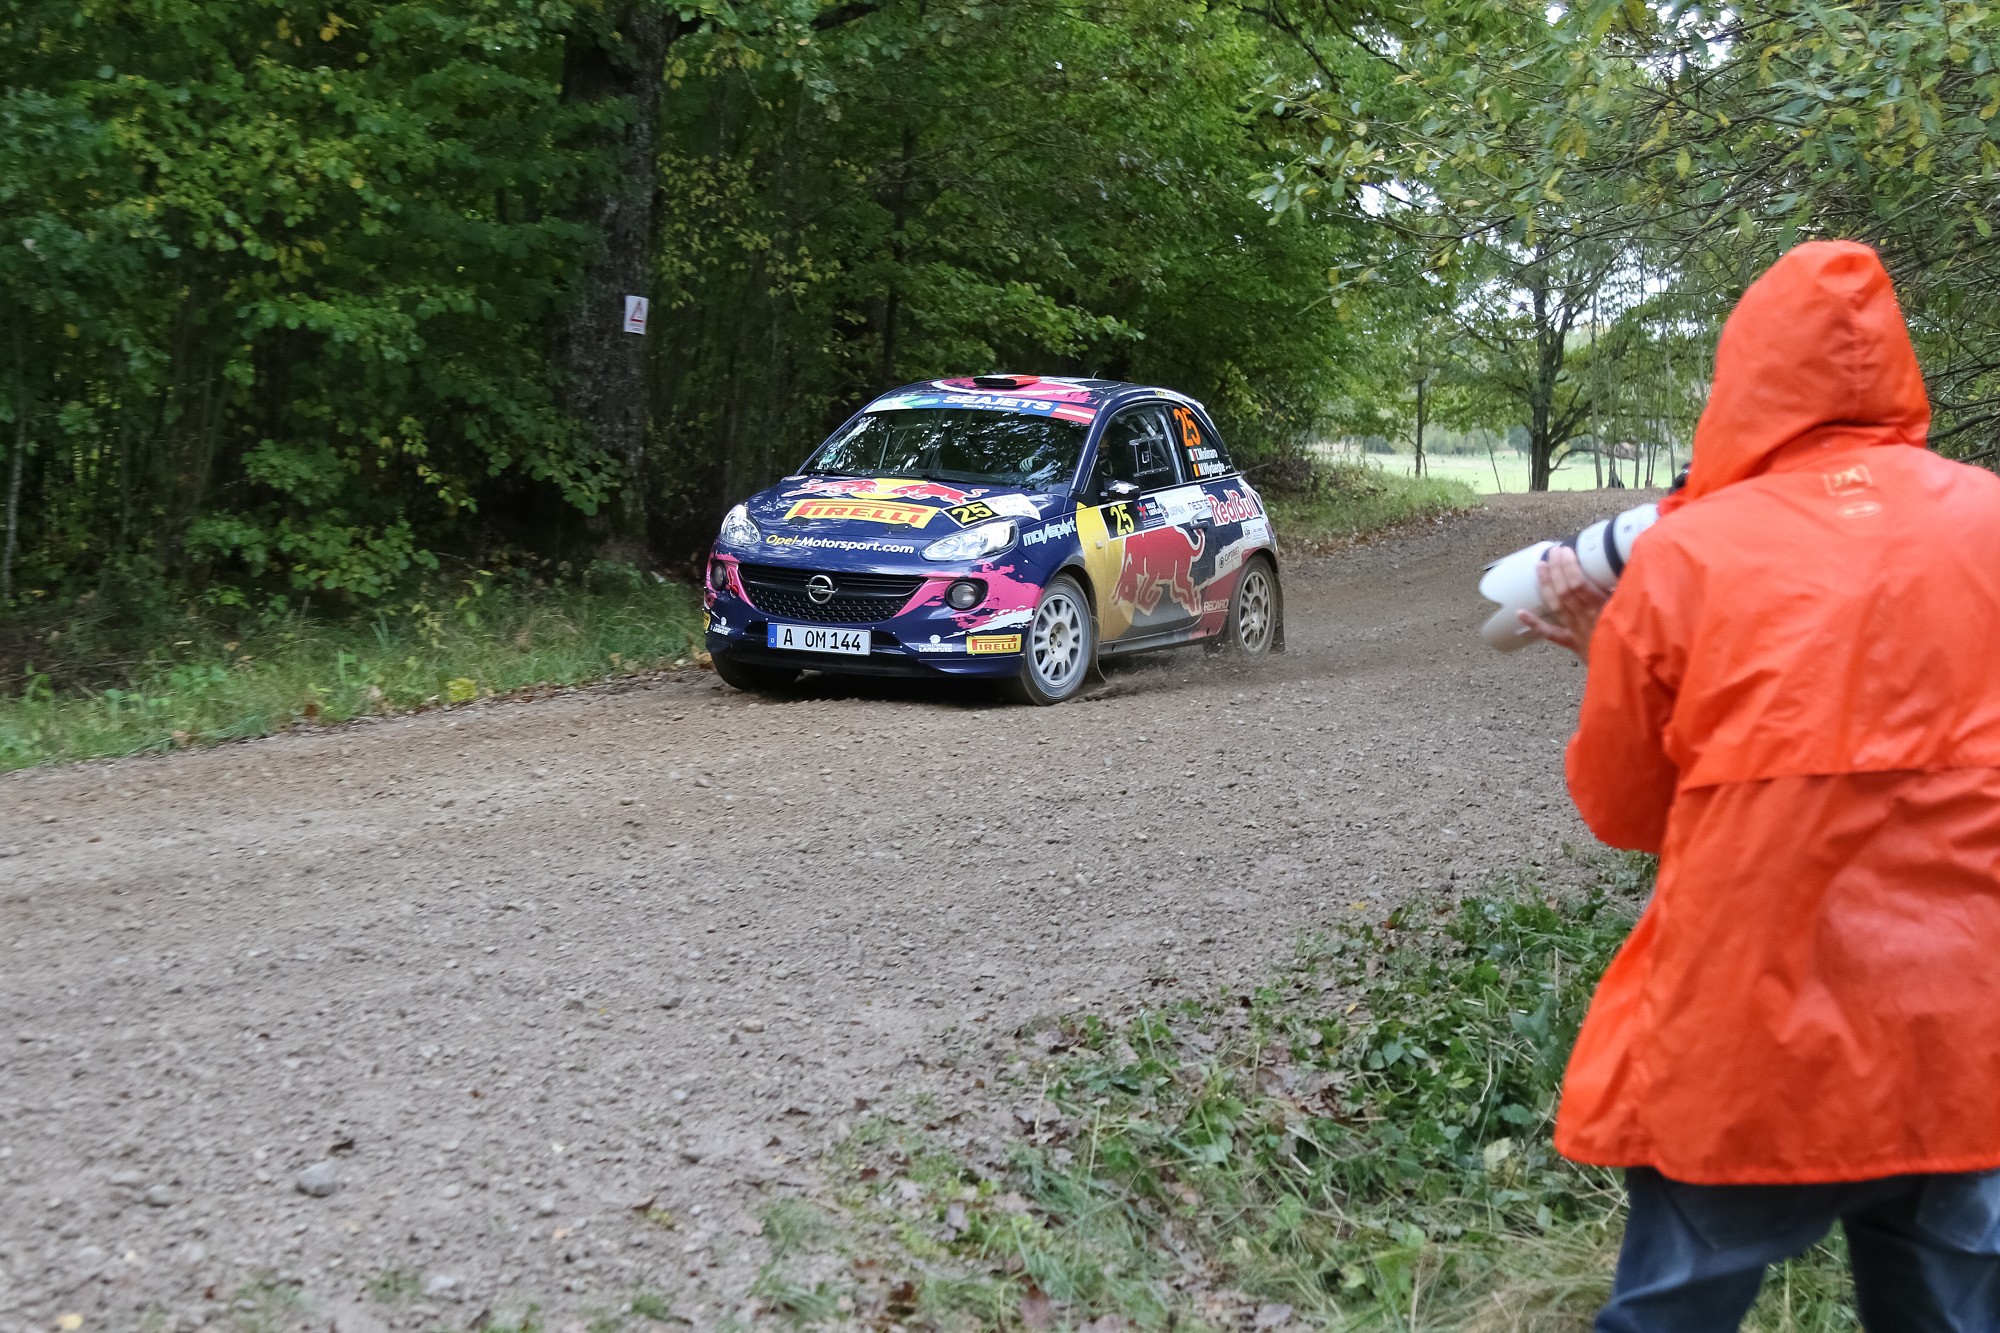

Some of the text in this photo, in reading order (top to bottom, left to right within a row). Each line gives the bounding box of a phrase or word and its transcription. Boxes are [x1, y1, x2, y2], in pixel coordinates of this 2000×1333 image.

[942, 395, 1053, 411] SEAJETS
[1173, 407, 1202, 447] 25
[793, 501, 929, 524] PIRELLI
[951, 502, 993, 524] 25
[1109, 503, 1135, 536] 25
[765, 534, 915, 555] Opel-Motorsport.com
[783, 628, 794, 646] A
[971, 637, 1018, 651] PIRELLI
